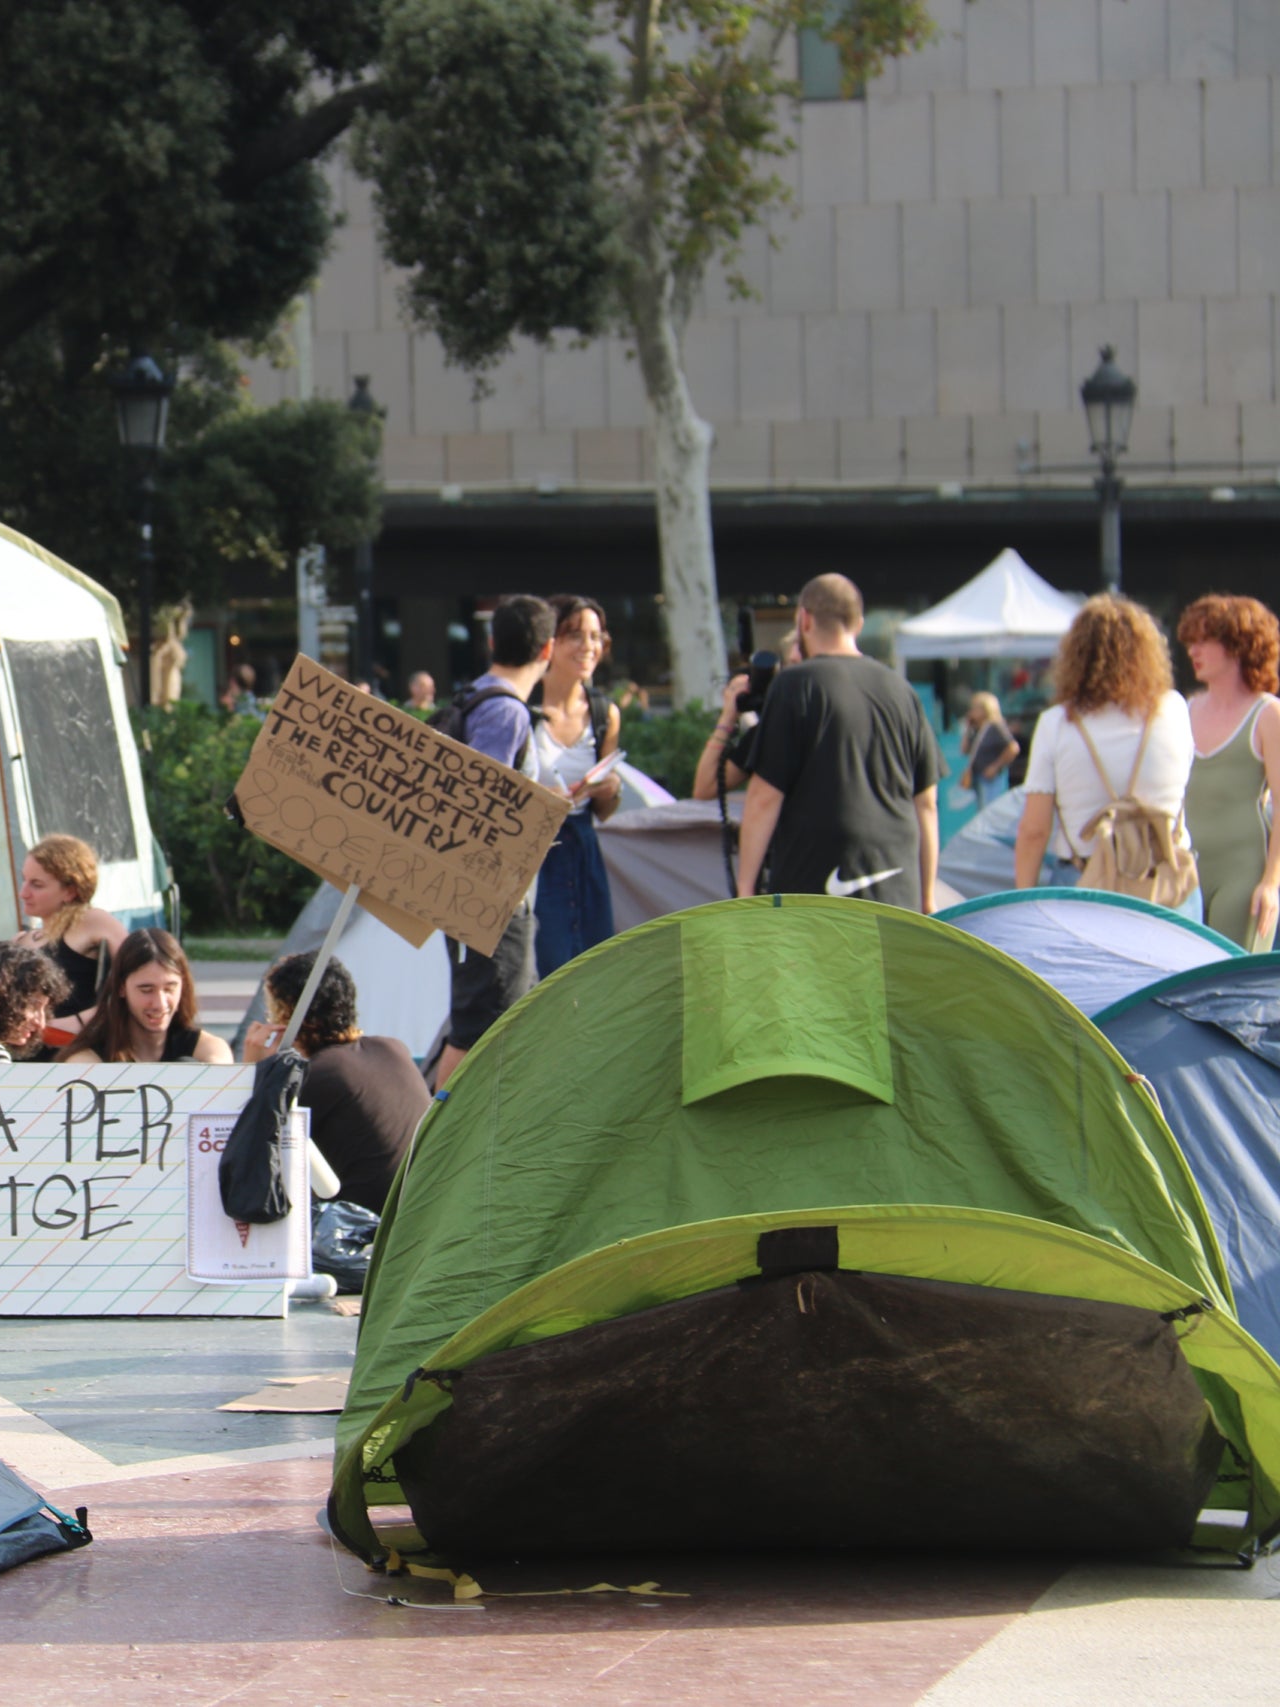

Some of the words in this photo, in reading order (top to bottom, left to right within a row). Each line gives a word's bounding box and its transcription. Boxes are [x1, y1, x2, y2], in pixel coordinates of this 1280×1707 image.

[271, 708, 322, 753] THE
[323, 739, 425, 802] REALITY
[417, 791, 451, 818] OF
[451, 805, 500, 848] THE
[298, 666, 431, 753] WELCOME
[434, 741, 464, 773] TO
[460, 760, 533, 811] SPAIN
[322, 770, 467, 854] COUNTRY
[415, 756, 480, 811] THIS
[478, 792, 524, 837] IS
[376, 843, 427, 890] FOR
[422, 871, 447, 903] A
[56, 1079, 174, 1171] PER
[198, 1140, 227, 1153] OC
[199, 1126, 210, 1140] 4
